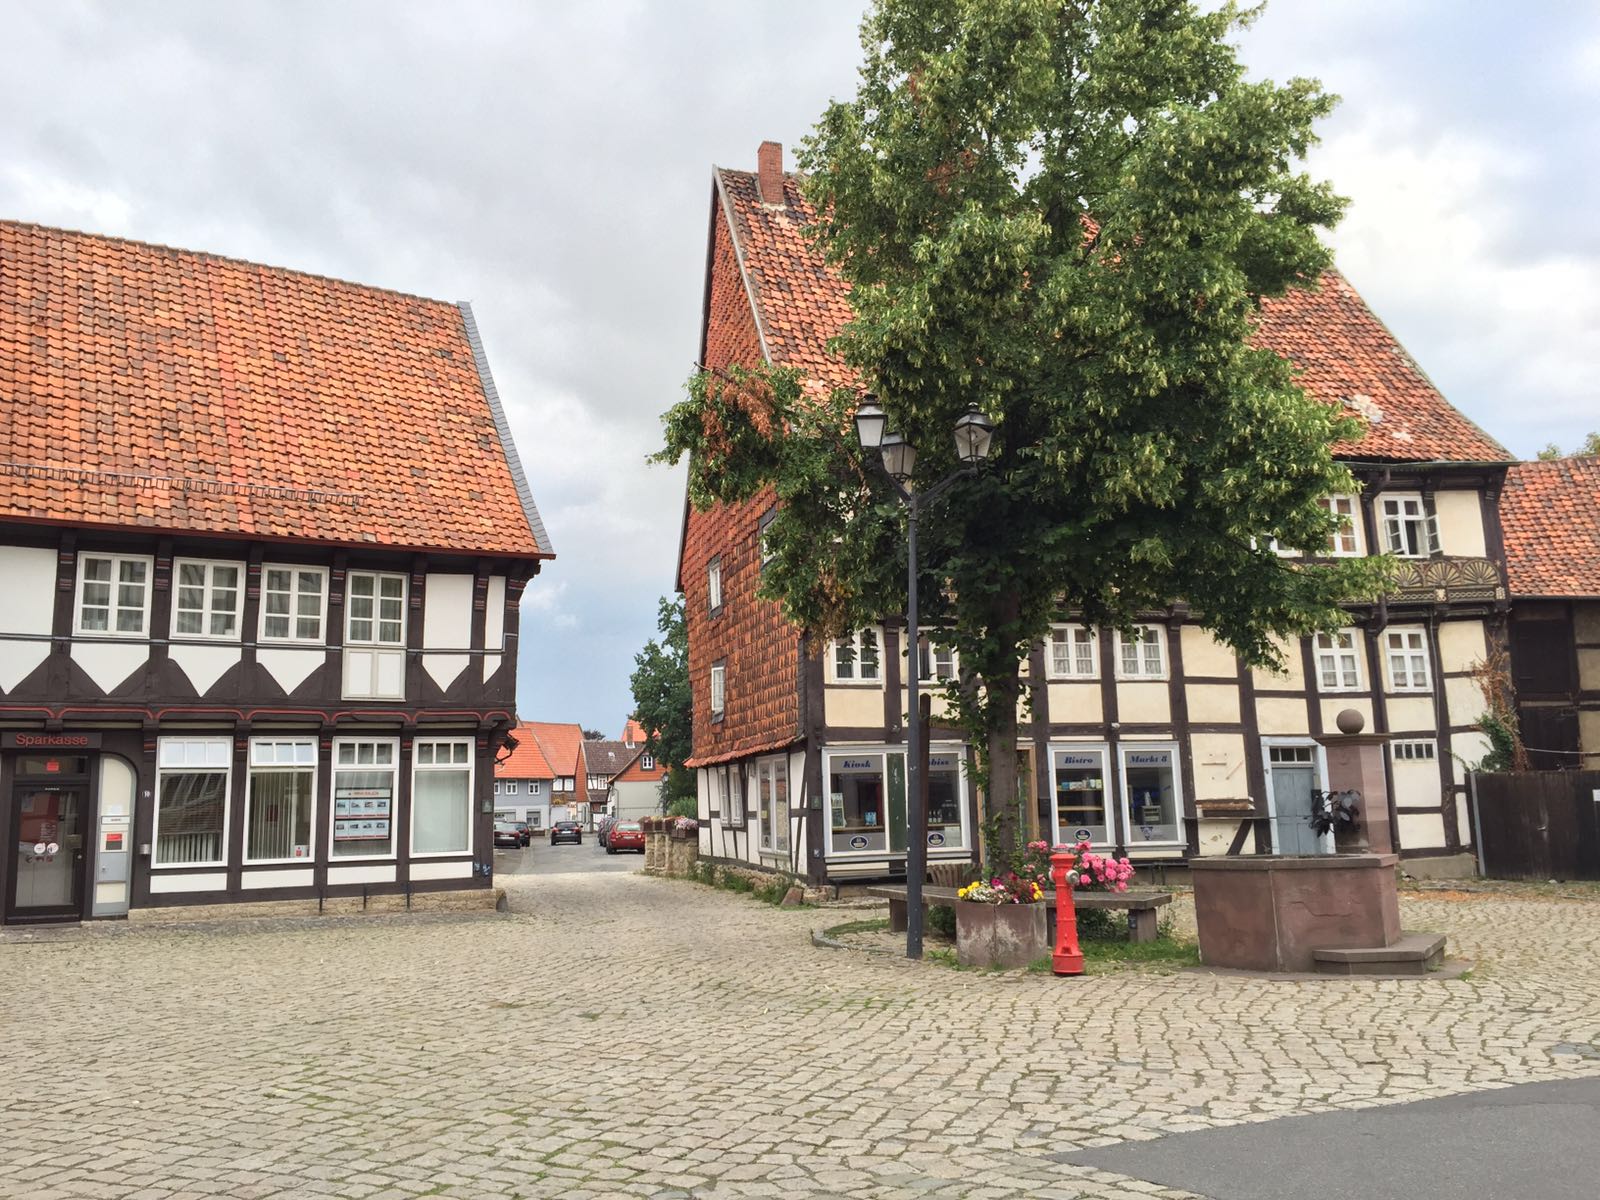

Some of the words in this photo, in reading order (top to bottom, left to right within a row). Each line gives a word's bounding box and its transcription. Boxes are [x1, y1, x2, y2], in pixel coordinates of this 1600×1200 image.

[16, 733, 88, 747] Sparkasse
[928, 758, 949, 767] biss
[1064, 756, 1093, 764] Bistro
[1129, 755, 1158, 763] Markt
[843, 760, 871, 769] Kiosk
